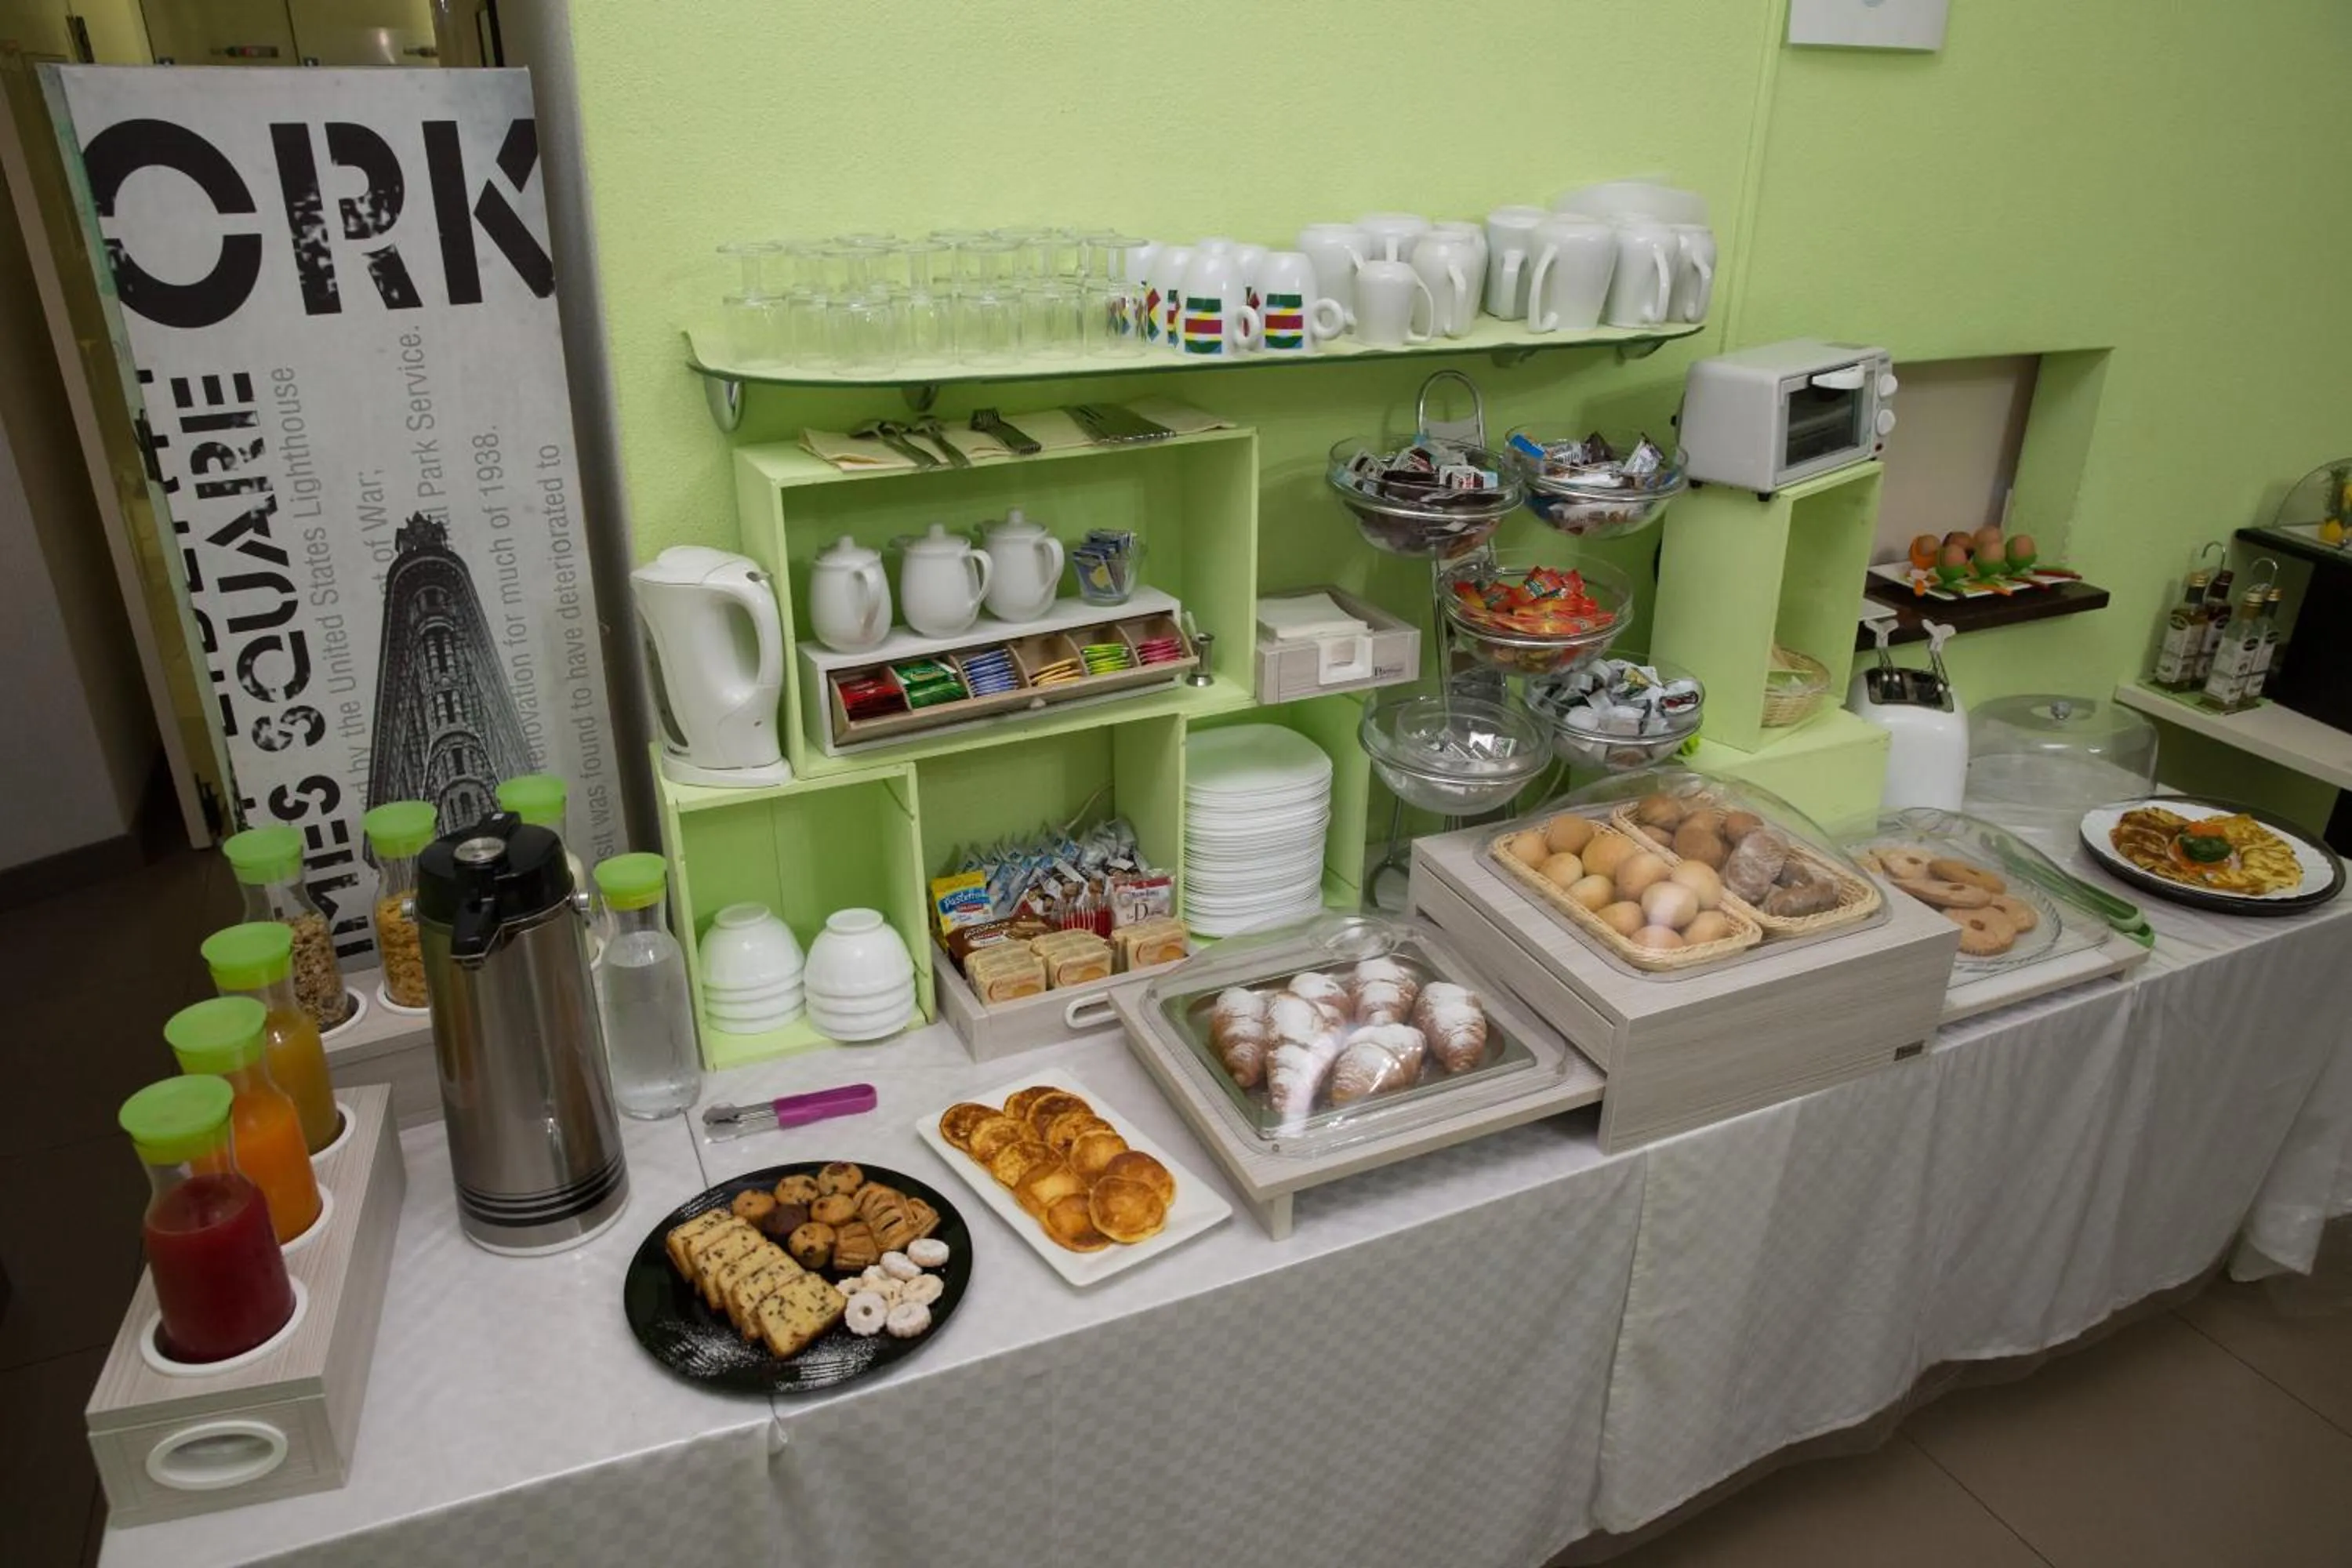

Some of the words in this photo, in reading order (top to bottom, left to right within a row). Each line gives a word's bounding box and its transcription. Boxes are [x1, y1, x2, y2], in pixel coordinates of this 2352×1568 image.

[82, 118, 556, 328] ORK
[398, 325, 436, 432] Service.
[271, 366, 322, 519] Lighthouse
[412, 439, 446, 499] Park
[472, 425, 505, 497] 1938.
[536, 445, 561, 470] to
[482, 506, 511, 530] of
[537, 477, 583, 621] deteriorated
[170, 372, 325, 753] SQUARE
[303, 527, 339, 607] States
[363, 538, 394, 563] of
[488, 538, 522, 607] much
[315, 615, 356, 695] United
[503, 614, 528, 649] for
[564, 627, 589, 681] have
[339, 699, 365, 739] the
[571, 688, 593, 711] to
[572, 715, 602, 779] found
[588, 785, 608, 827] was
